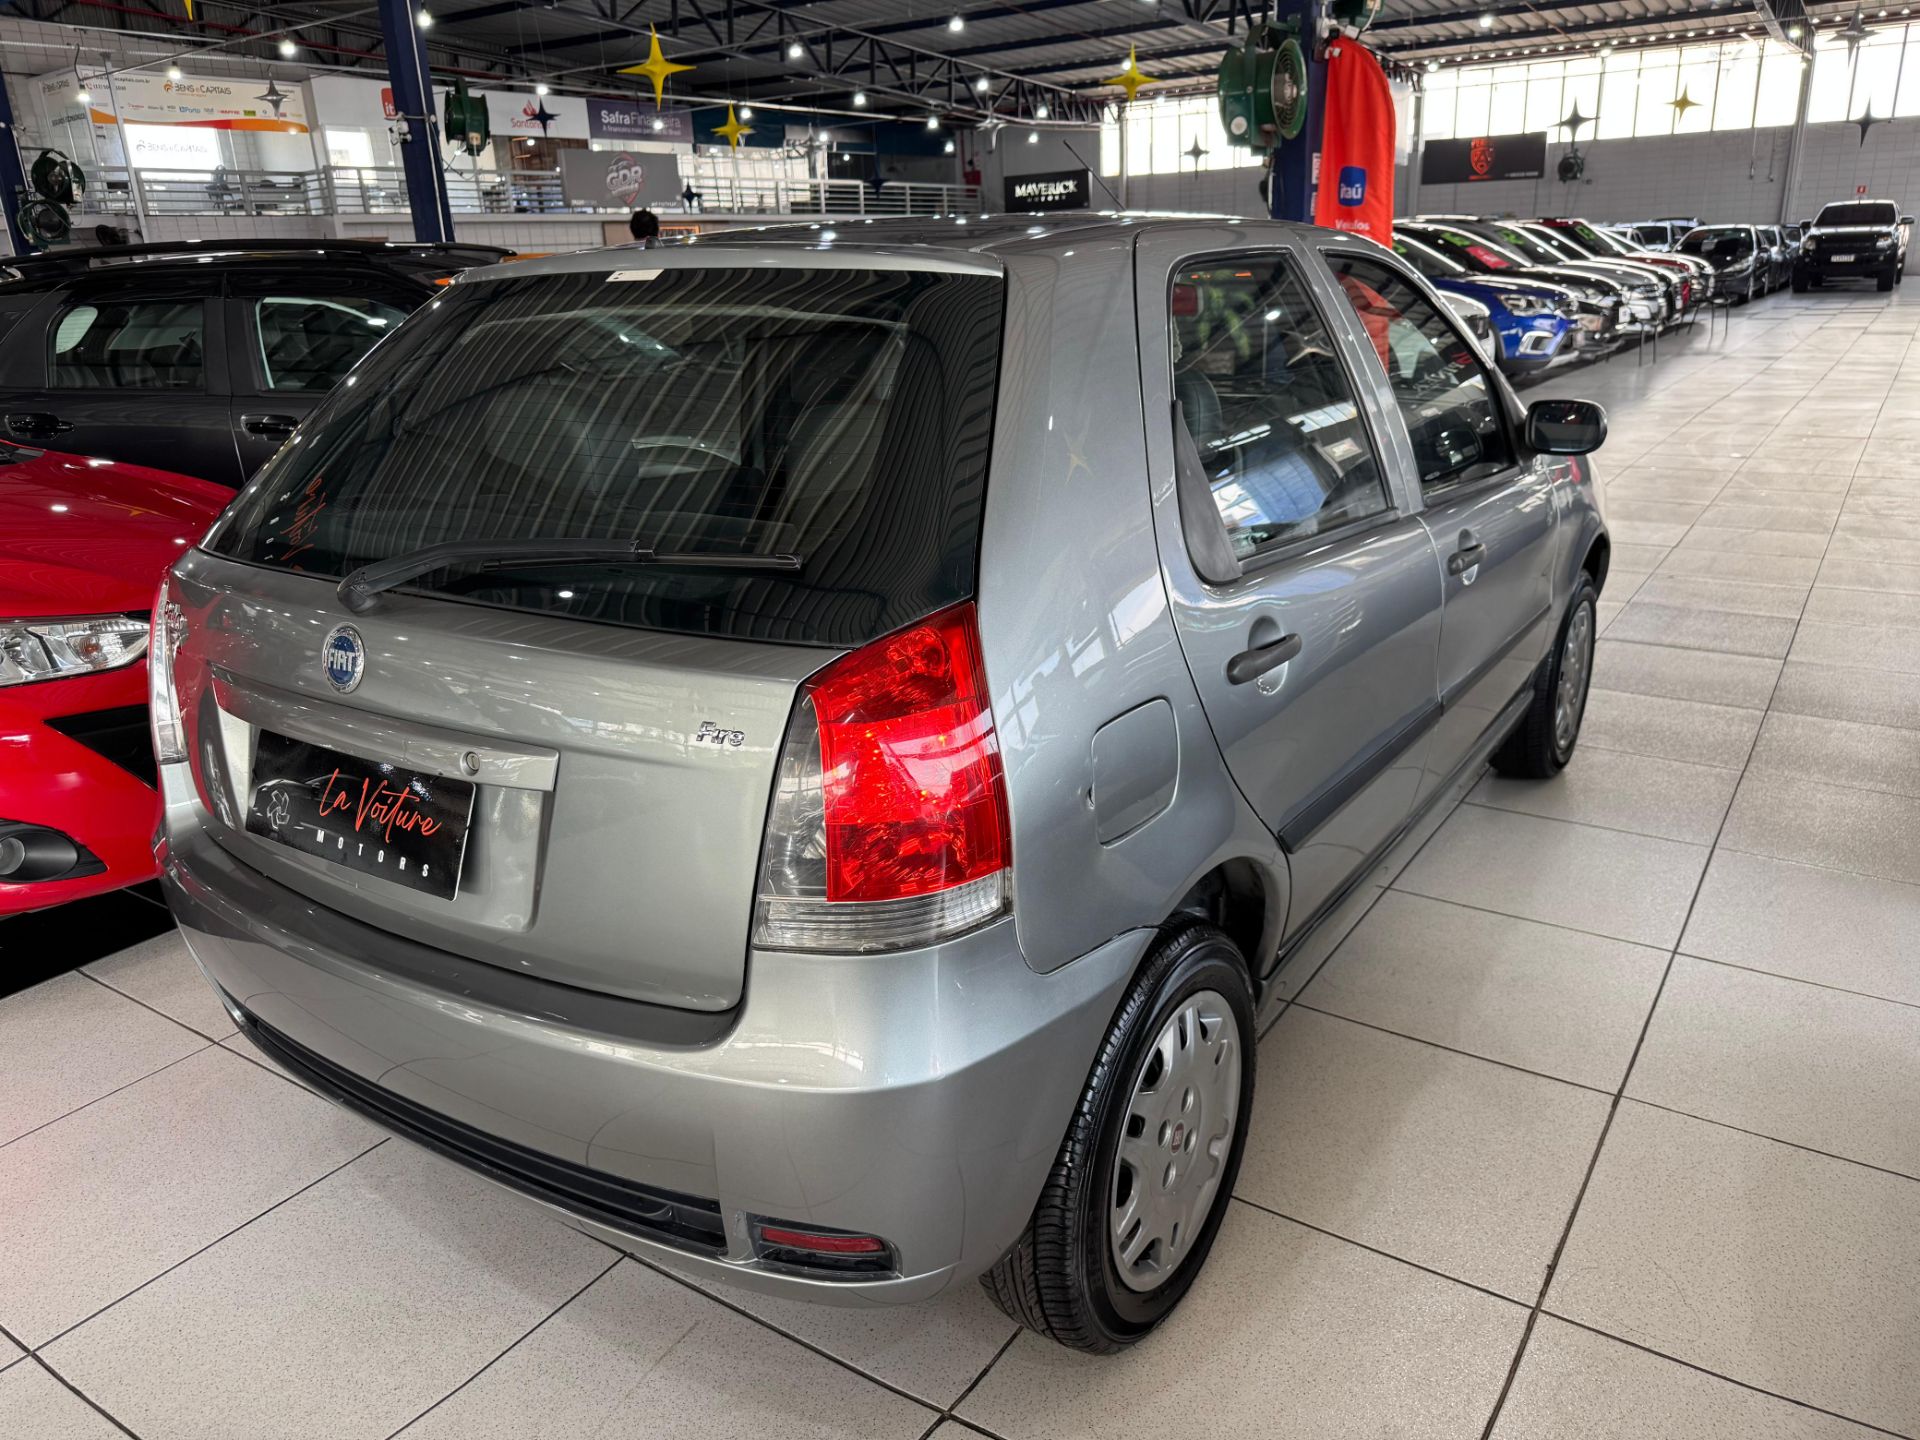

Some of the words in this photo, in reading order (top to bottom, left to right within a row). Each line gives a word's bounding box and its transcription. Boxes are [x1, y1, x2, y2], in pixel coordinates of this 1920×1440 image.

[1015, 180, 1078, 198] MAVERICK
[328, 648, 356, 672] FIAT
[696, 720, 745, 747] Fire
[319, 767, 351, 817] La
[355, 777, 442, 844] Voiture
[316, 829, 430, 877] MOTORS
